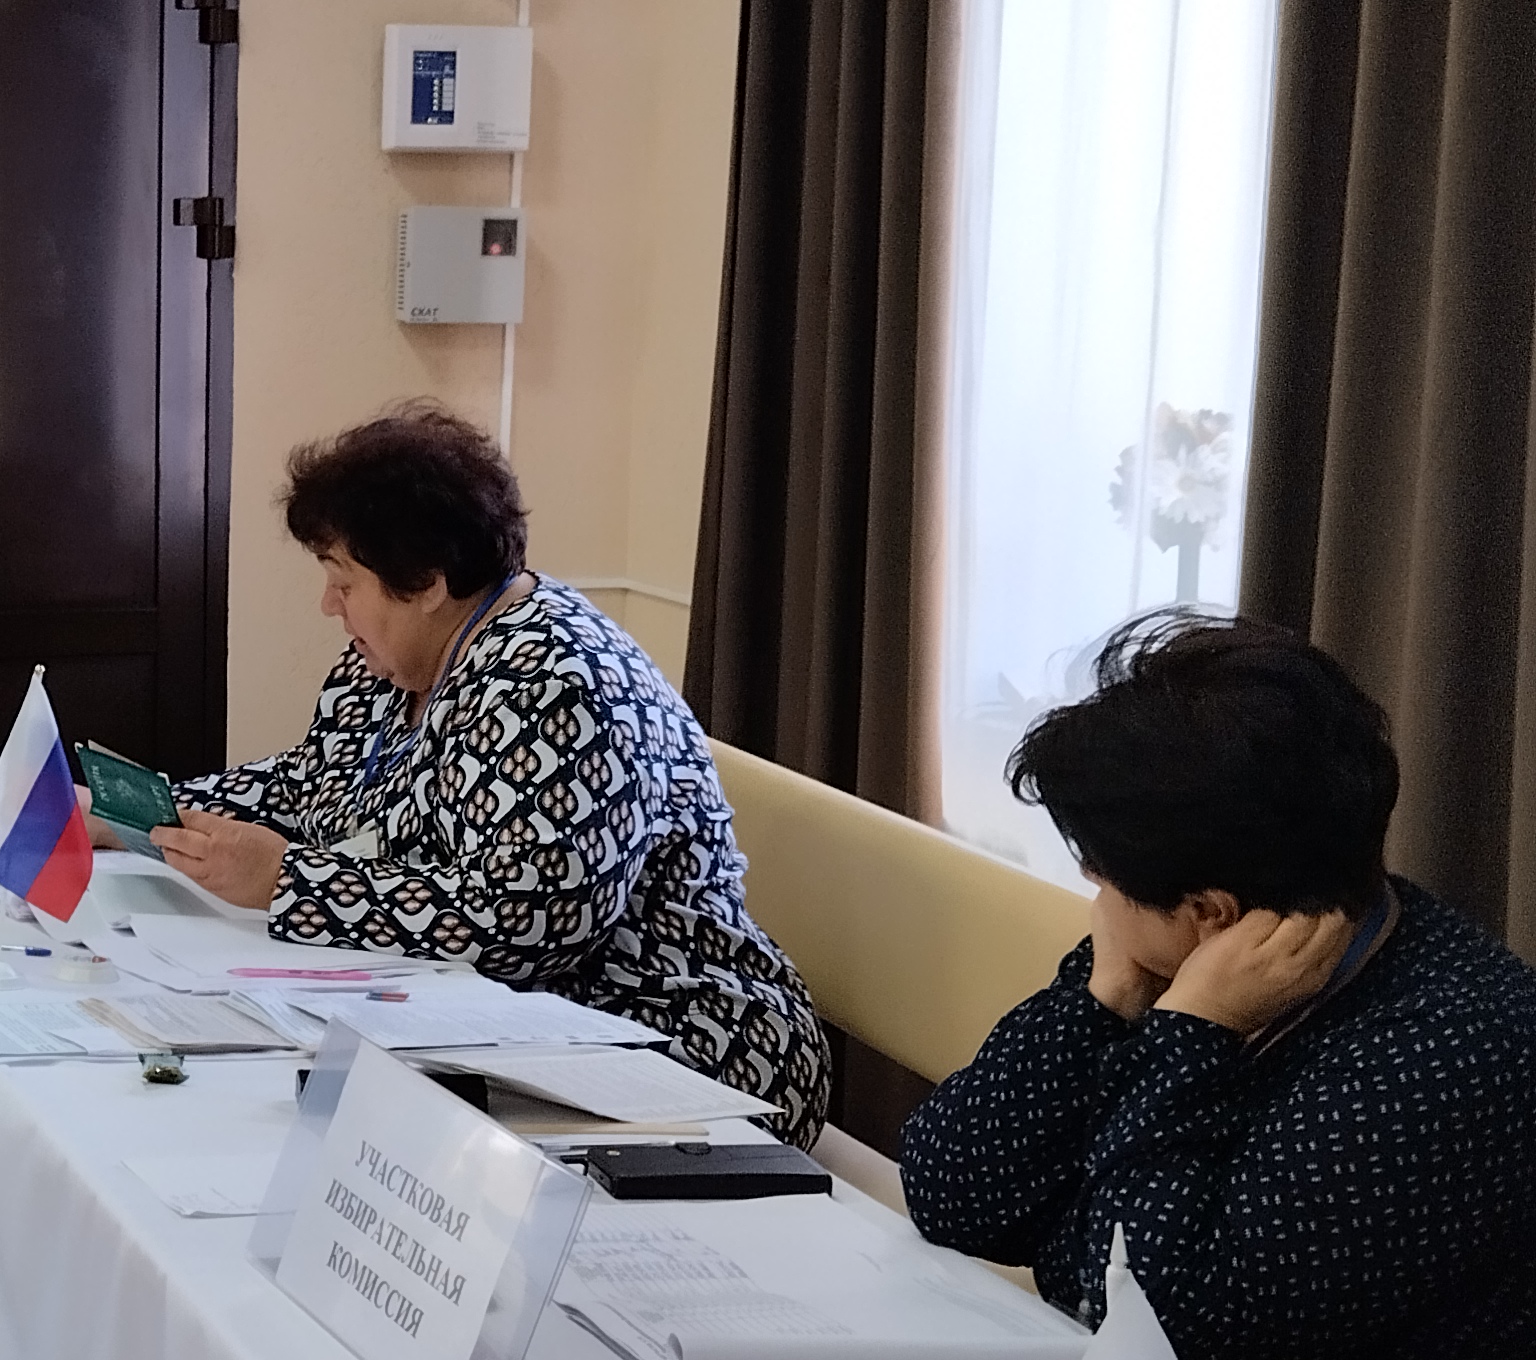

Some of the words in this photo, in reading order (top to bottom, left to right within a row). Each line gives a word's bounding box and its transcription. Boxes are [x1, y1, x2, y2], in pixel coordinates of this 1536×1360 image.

[324, 1178, 466, 1306] ИЗБИРАТЕЛЬНАЯ
[354, 1140, 470, 1242] УЧАСТКОВАЯ
[326, 1240, 424, 1339] КОМИССИЯ
